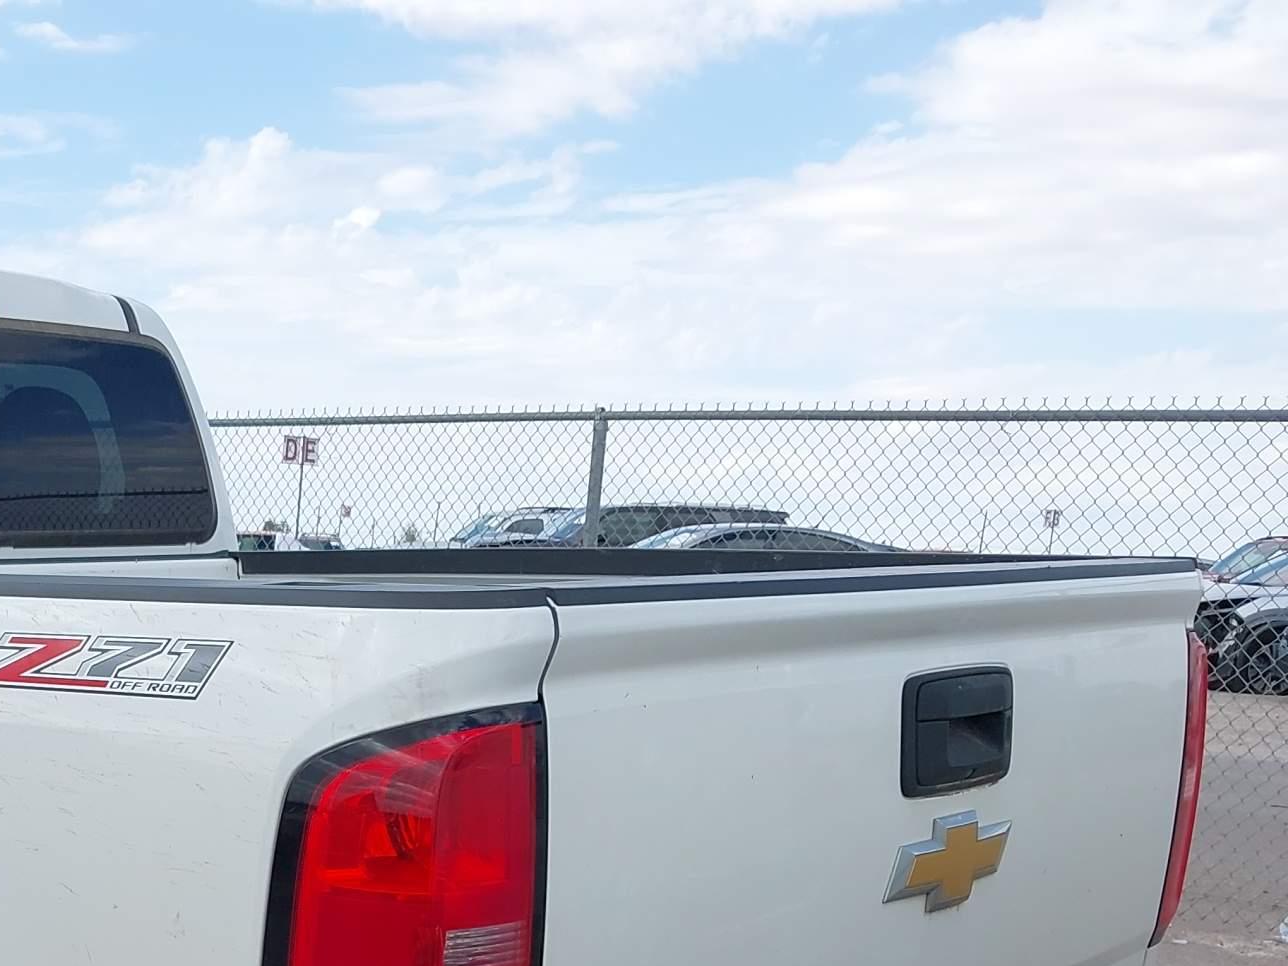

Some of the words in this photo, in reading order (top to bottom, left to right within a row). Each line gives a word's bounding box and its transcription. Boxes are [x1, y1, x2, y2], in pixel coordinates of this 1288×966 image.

[285, 438, 298, 461] D
[304, 439, 317, 464] E
[110, 680, 144, 691] OFF
[146, 682, 198, 695] ROAD
